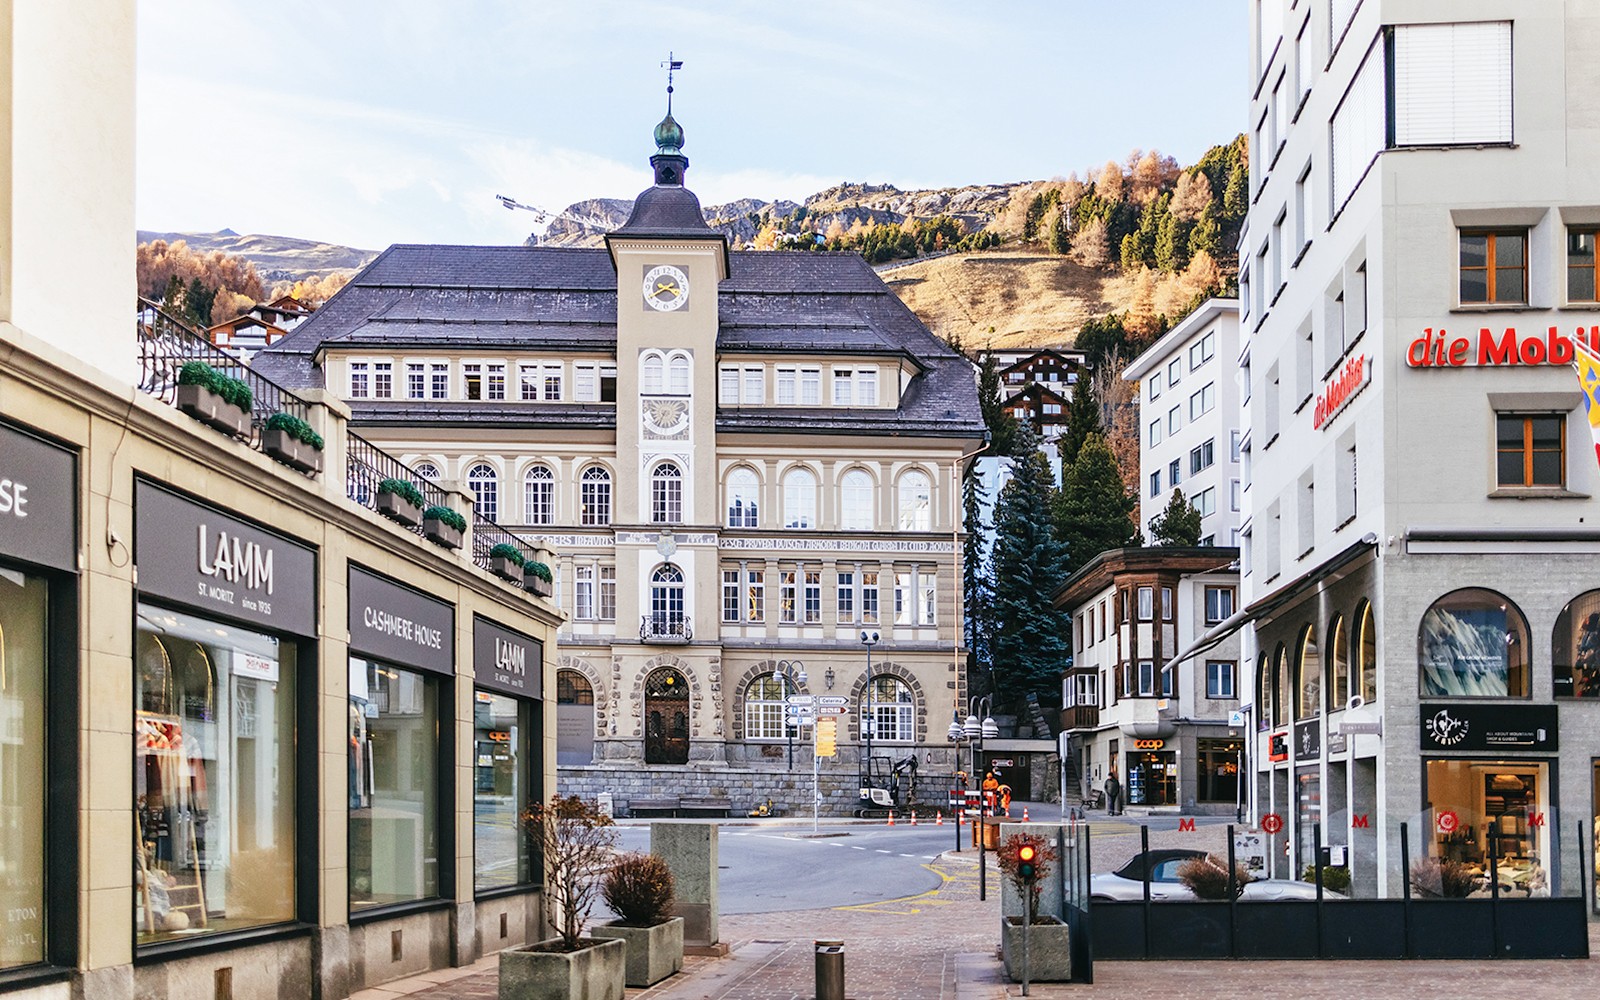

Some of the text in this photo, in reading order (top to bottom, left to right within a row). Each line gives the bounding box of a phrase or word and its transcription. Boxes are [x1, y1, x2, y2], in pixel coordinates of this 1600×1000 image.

[1407, 327, 1469, 366] die
[1314, 395, 1325, 430] die
[0, 479, 29, 517] SE
[198, 524, 273, 596] LAMM
[198, 582, 271, 615] ST. MORITZ since 1935
[364, 606, 442, 649] CASHMERE HOUSE
[495, 637, 525, 677] LAMM
[1134, 739, 1164, 750] coop
[8, 907, 37, 922] ETON
